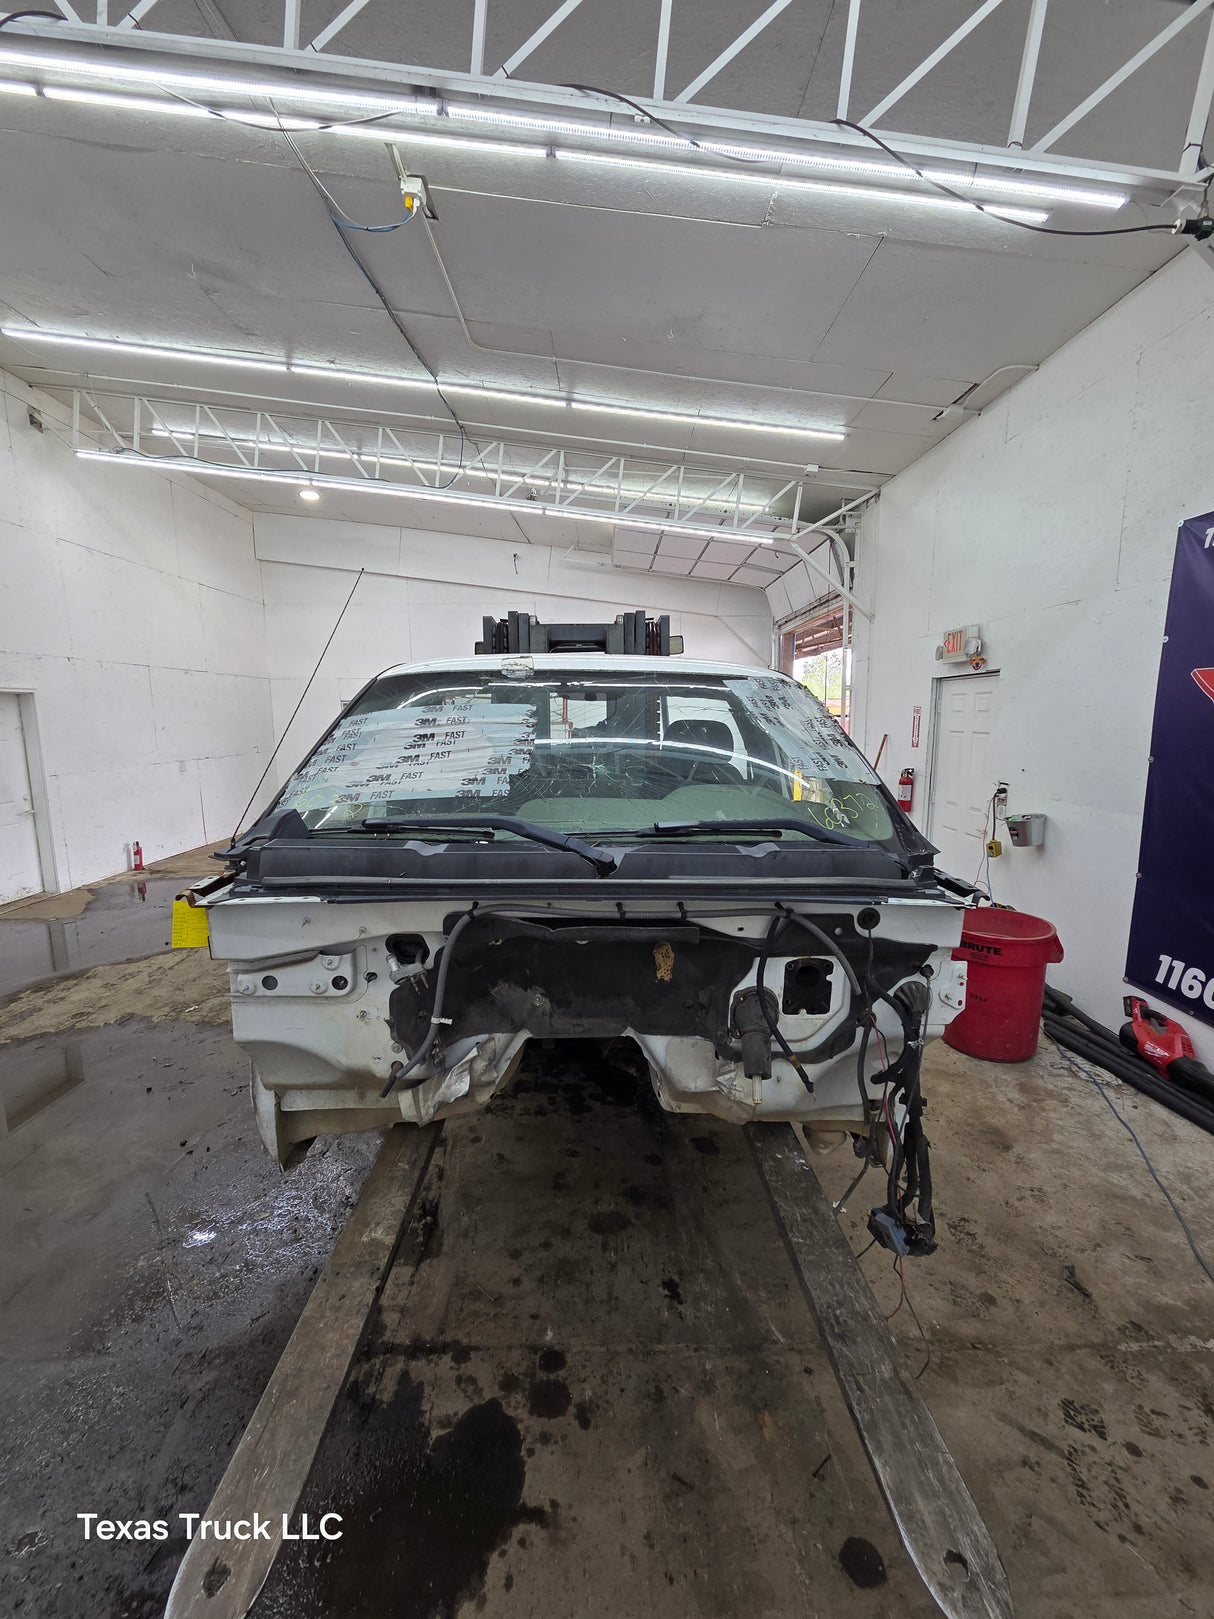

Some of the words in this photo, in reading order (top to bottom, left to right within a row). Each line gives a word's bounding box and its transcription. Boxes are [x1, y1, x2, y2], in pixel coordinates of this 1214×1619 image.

[946, 630, 963, 653] EXIT
[421, 705, 444, 713] 3M
[349, 717, 369, 727] FAST
[414, 717, 437, 726] 3M
[446, 716, 467, 725] FAST
[412, 732, 435, 743] 3M
[444, 731, 466, 740] FAST
[335, 742, 358, 752] FAST
[324, 754, 347, 764] FAST
[396, 754, 420, 764] 3M
[429, 750, 452, 760] FAST
[486, 756, 512, 765] 3M
[316, 766, 339, 775] FAST
[366, 774, 392, 783] 3M
[400, 771, 424, 780] FAST
[460, 776, 486, 786] 3M
[335, 793, 361, 803] 3M
[370, 790, 395, 800] FAST
[455, 789, 481, 798] 3M
[960, 940, 1002, 956] BRUTE
